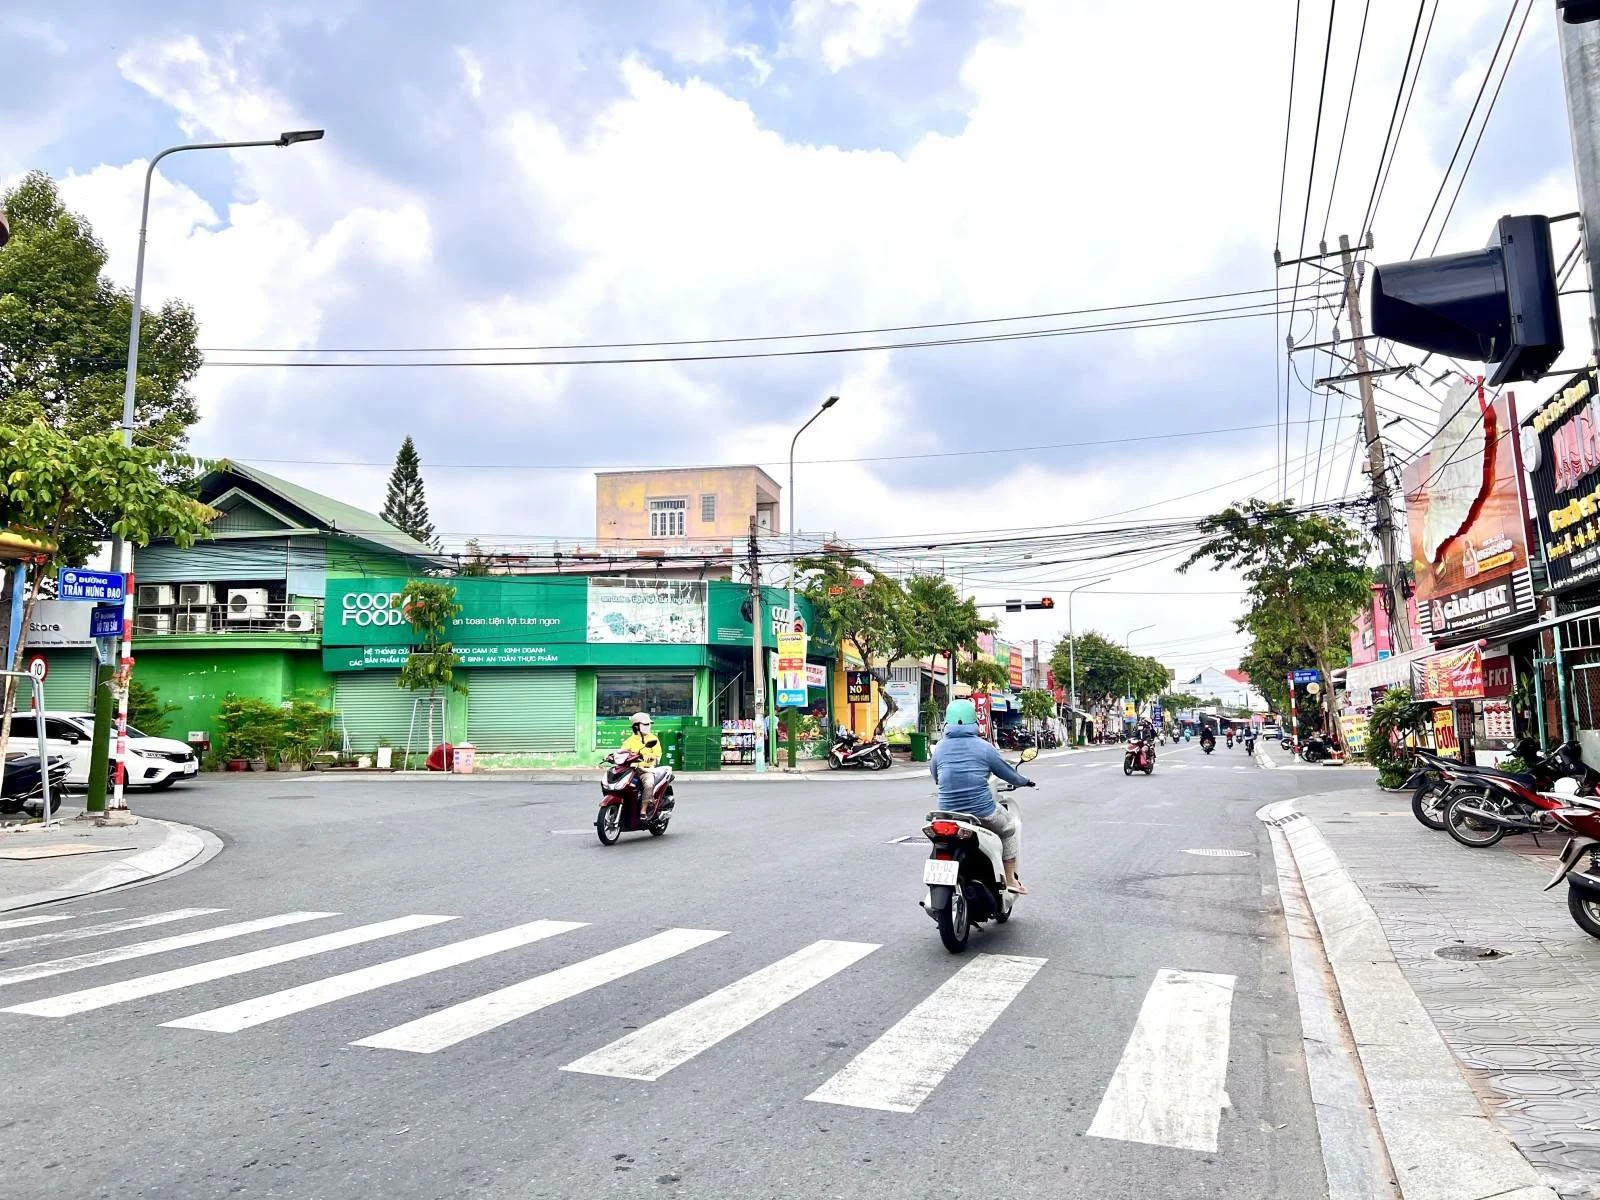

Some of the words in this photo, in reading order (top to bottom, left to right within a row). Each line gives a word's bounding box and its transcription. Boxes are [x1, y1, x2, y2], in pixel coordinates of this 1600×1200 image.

[79, 576, 108, 584] ĐƯỜNG
[64, 582, 83, 596] TRẦN
[85, 585, 104, 598] HƯNG
[106, 588, 121, 600] ĐẠO
[29, 622, 60, 632] Store
[452, 618, 463, 626] an
[34, 663, 43, 676] 10
[1488, 667, 1509, 687] FKT
